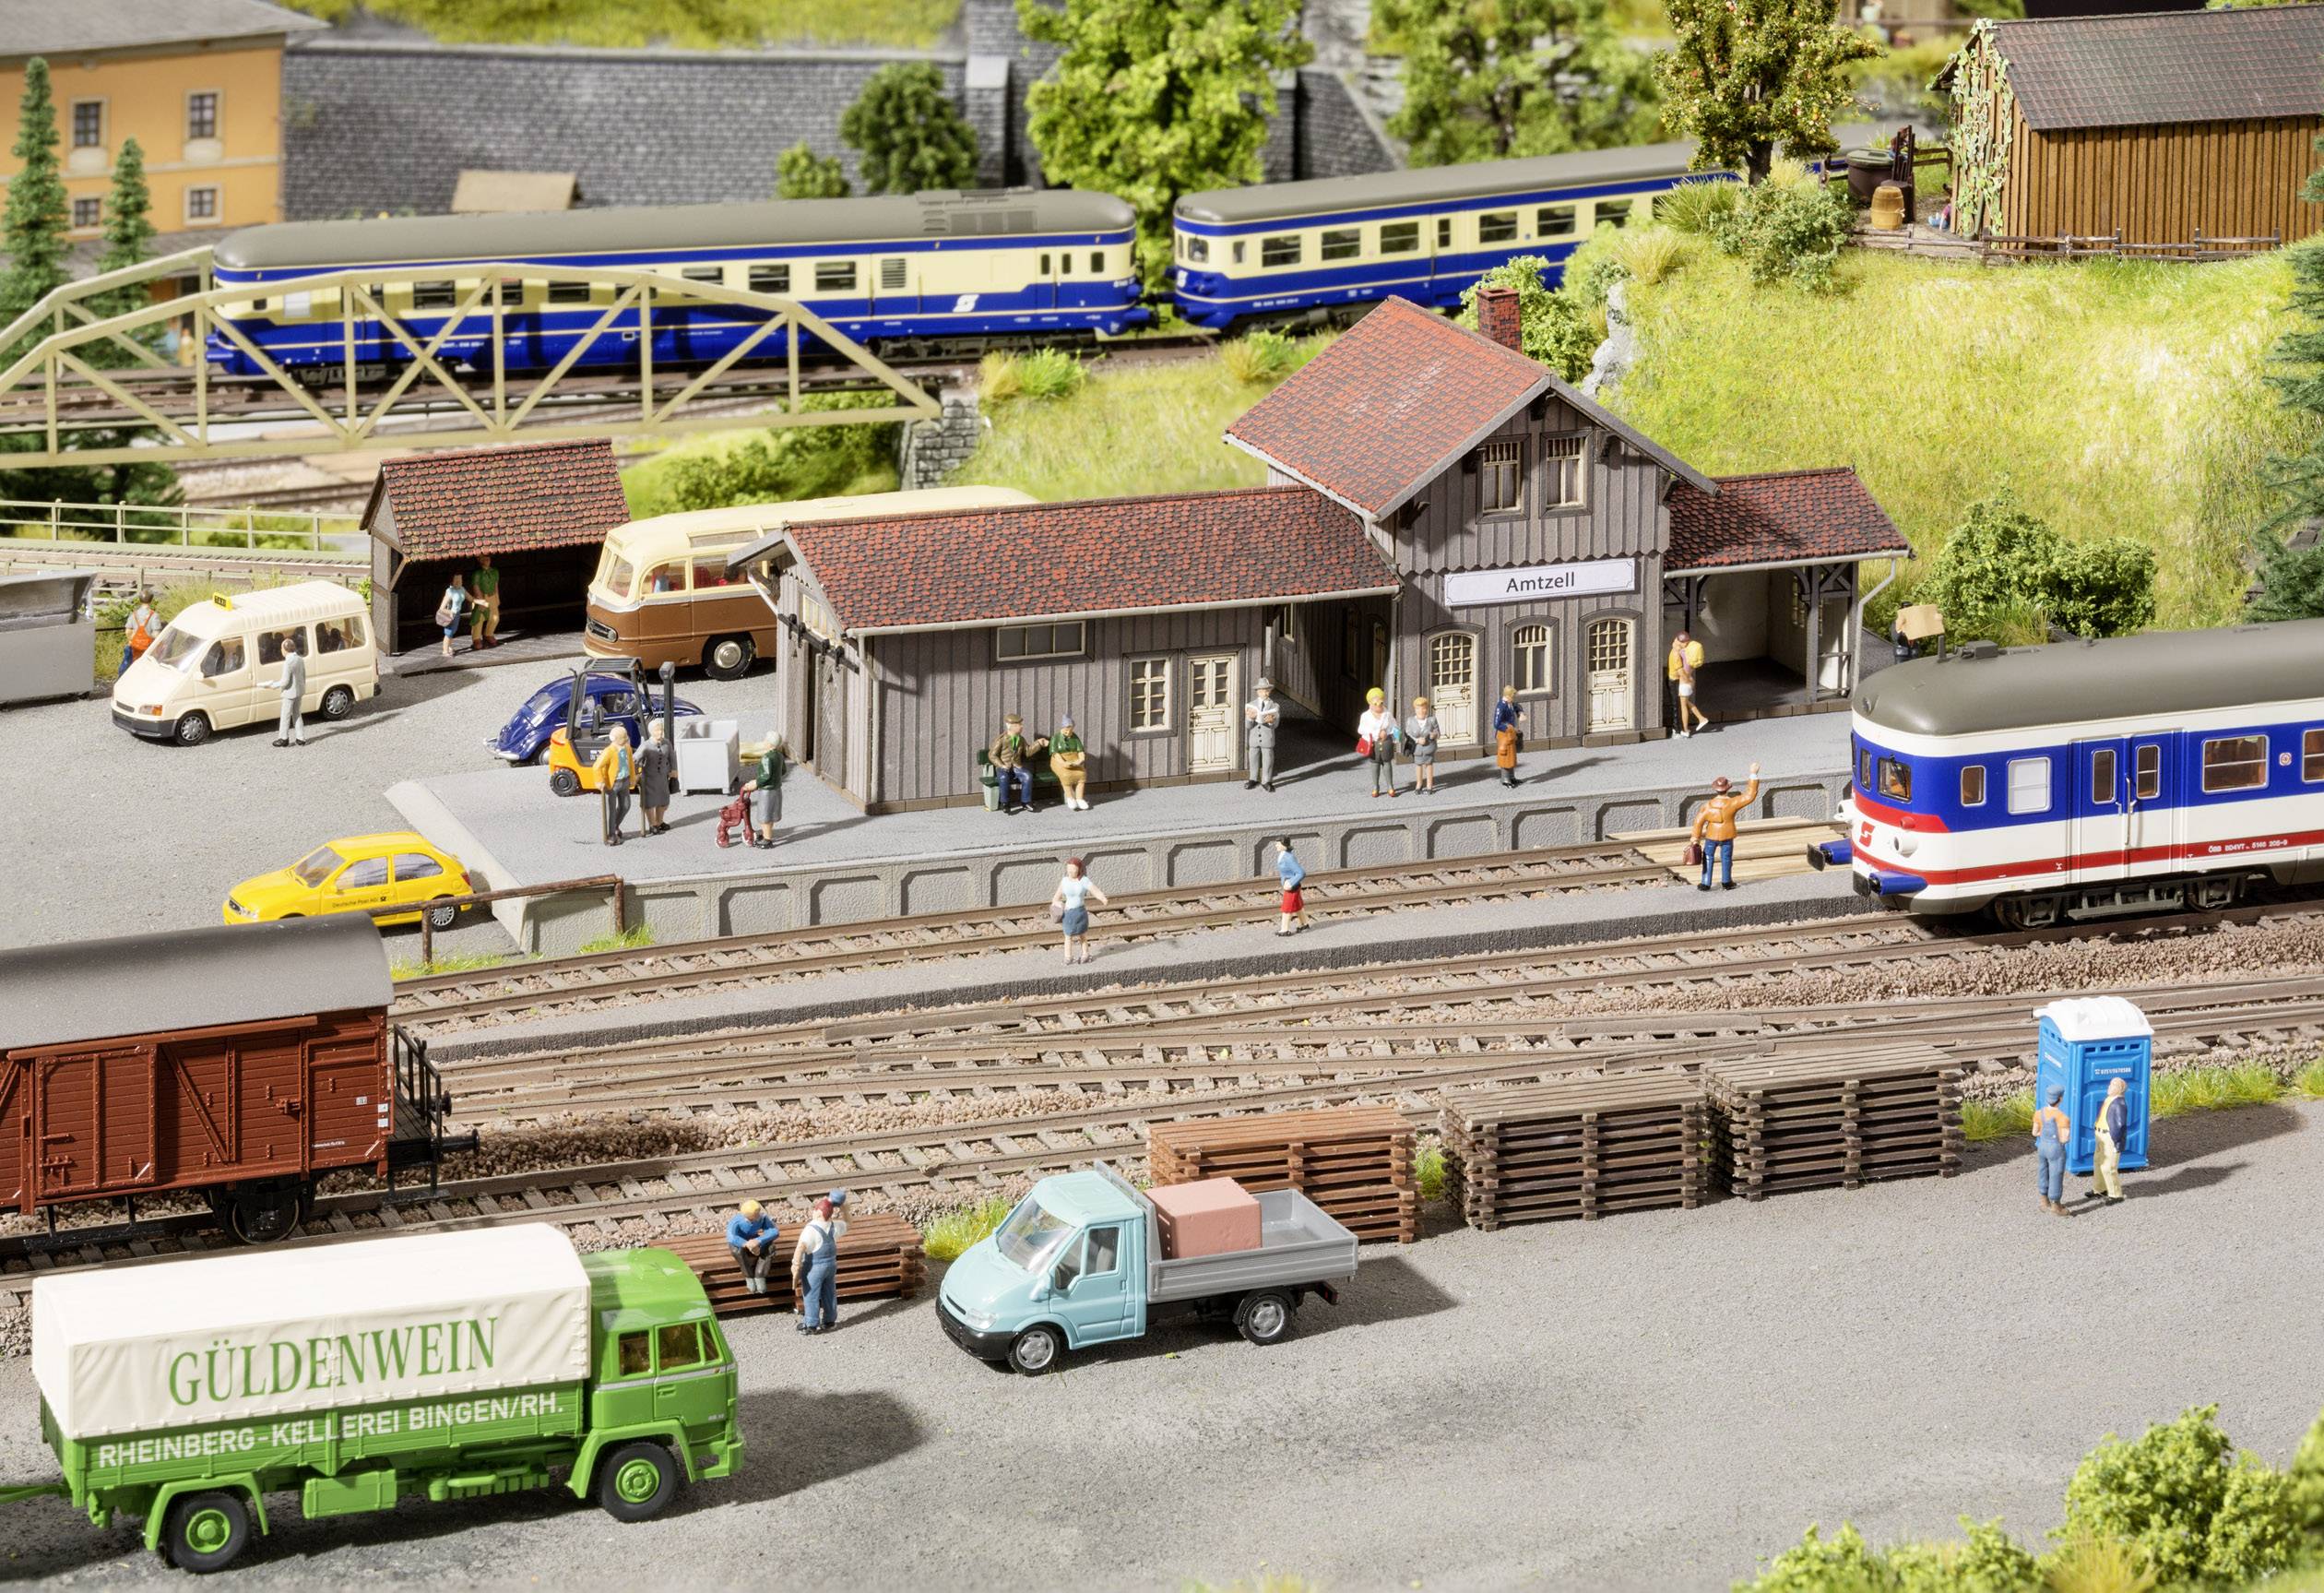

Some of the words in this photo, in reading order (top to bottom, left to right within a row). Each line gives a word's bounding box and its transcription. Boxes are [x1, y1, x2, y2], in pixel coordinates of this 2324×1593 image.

[1506, 571, 1575, 593] Amtzell
[169, 1317, 498, 1406] GÜLDENWEIN
[409, 1391, 563, 1432] BINGEN/RH.
